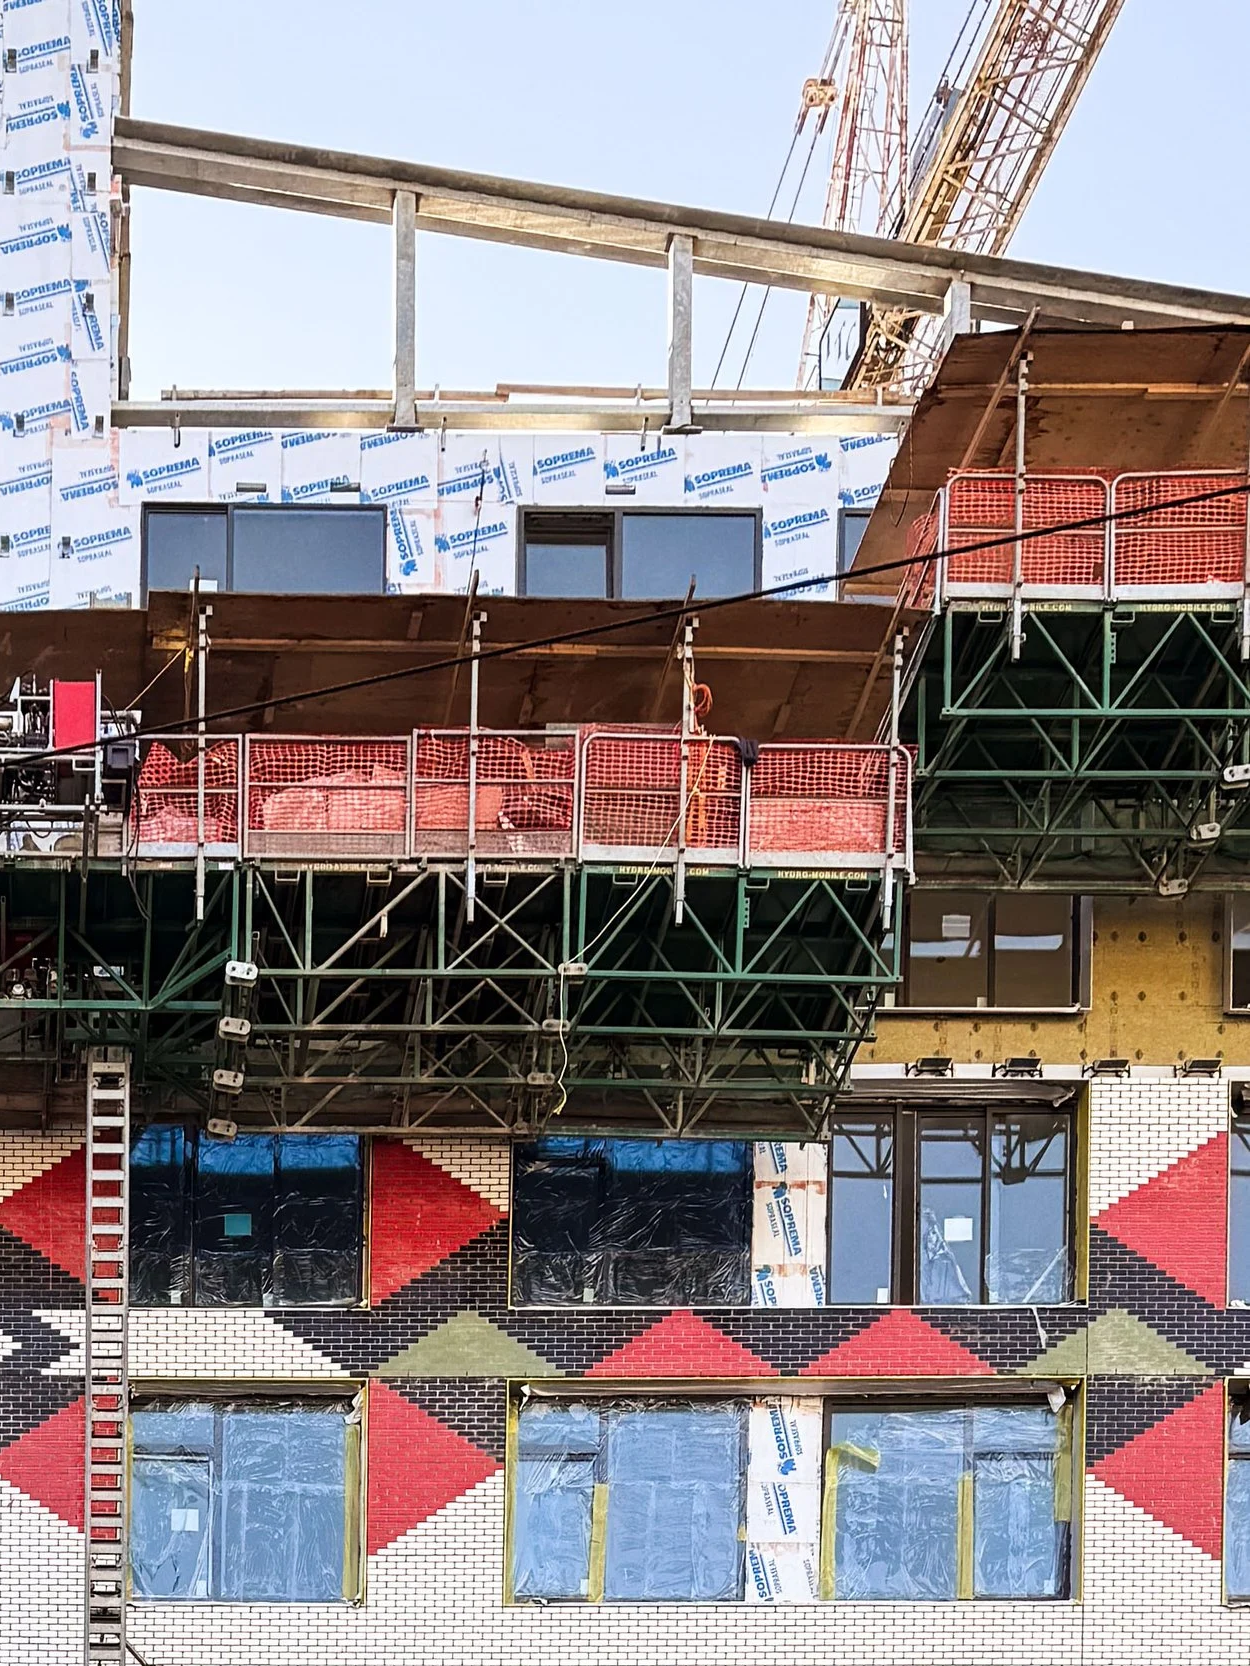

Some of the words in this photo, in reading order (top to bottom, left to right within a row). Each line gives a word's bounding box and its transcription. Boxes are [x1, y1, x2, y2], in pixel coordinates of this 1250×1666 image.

[18, 36, 70, 57] OPREMA
[0, 232, 58, 254] SOPREMA
[15, 279, 71, 300] SOPREMA
[0, 352, 58, 375] SOPREMA
[143, 457, 200, 478] SOPREMA
[537, 448, 594, 468] SOPREMA
[619, 448, 676, 469] SOPREMA
[695, 462, 751, 484] SOPREMA
[771, 509, 828, 530] SOPREMA
[13, 525, 50, 542] SOPRE
[74, 527, 131, 547] SOPREMA
[766, 1202, 779, 1237] SOPRASEAL
[781, 1199, 802, 1256] SOPREMA
[778, 1483, 796, 1534] OPREMA
